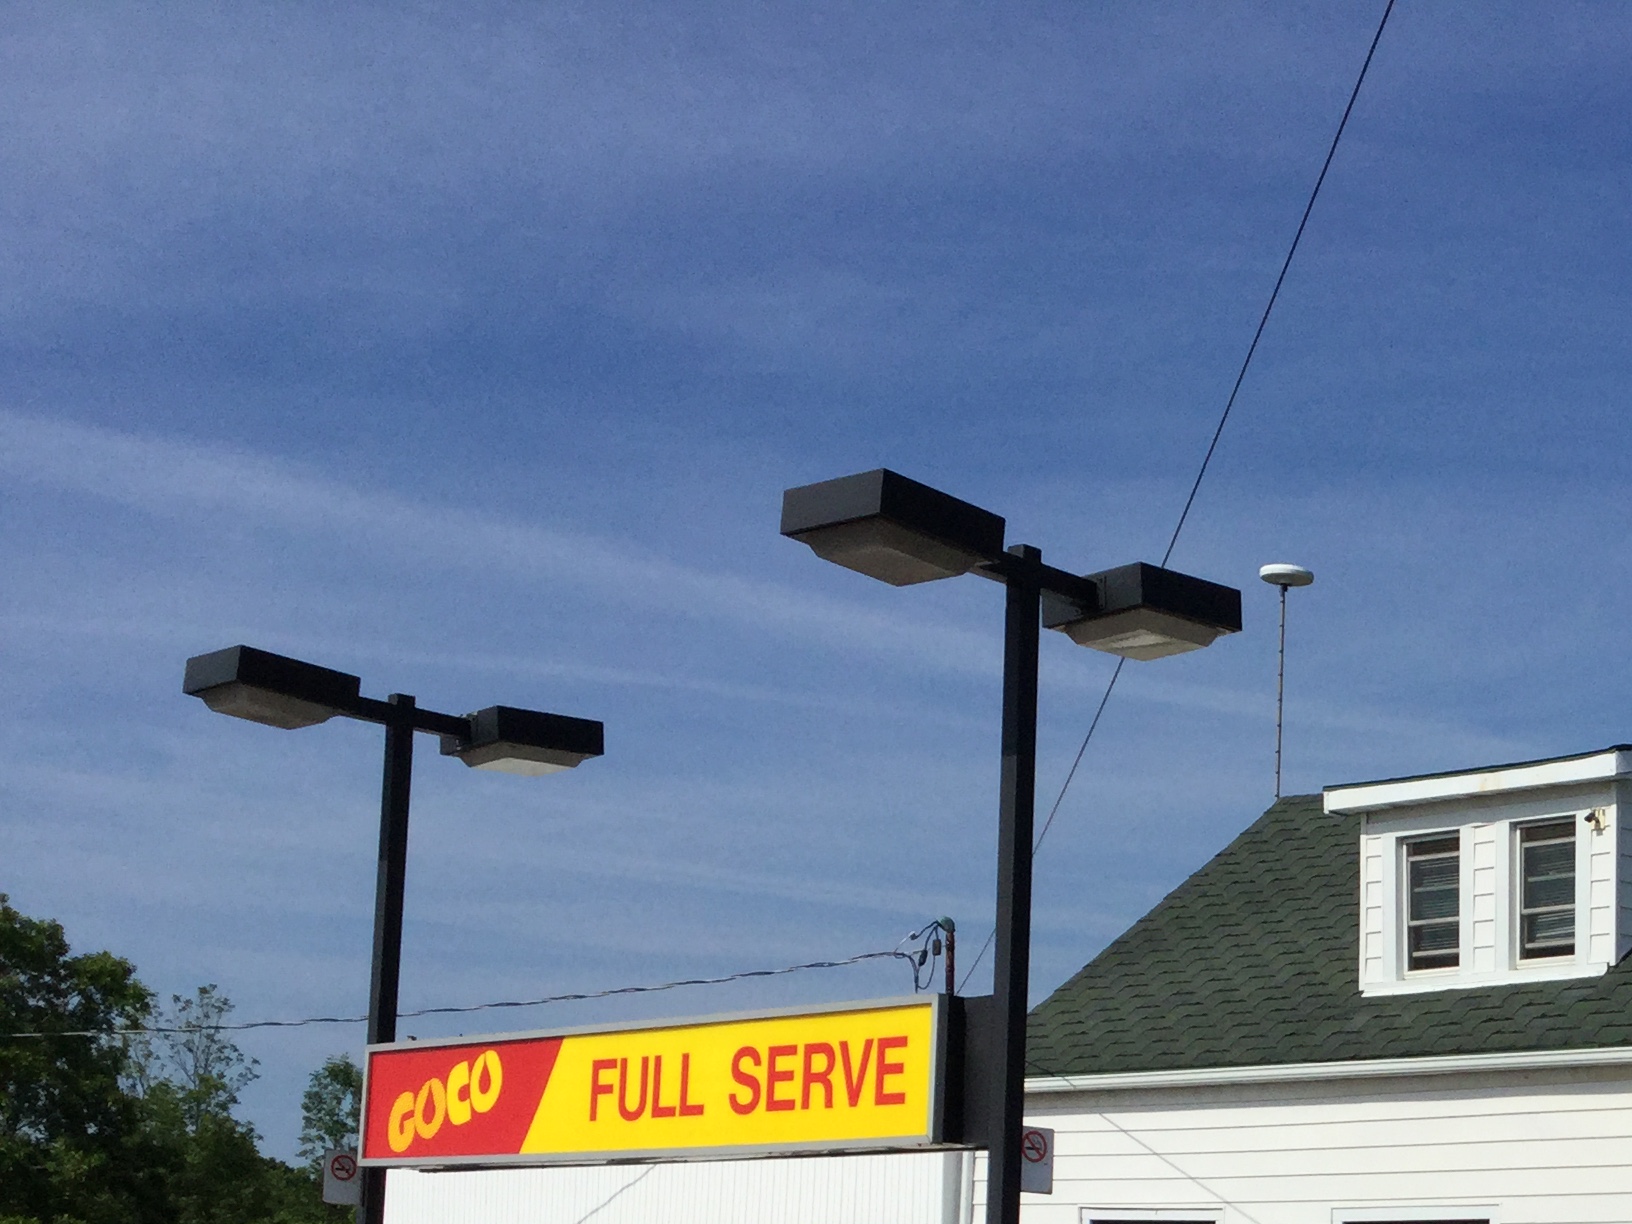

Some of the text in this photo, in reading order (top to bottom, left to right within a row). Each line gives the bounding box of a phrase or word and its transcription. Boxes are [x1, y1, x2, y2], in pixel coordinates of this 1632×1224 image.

[388, 1050, 503, 1153] GOCO
[588, 1035, 908, 1122] FULL SERVE
